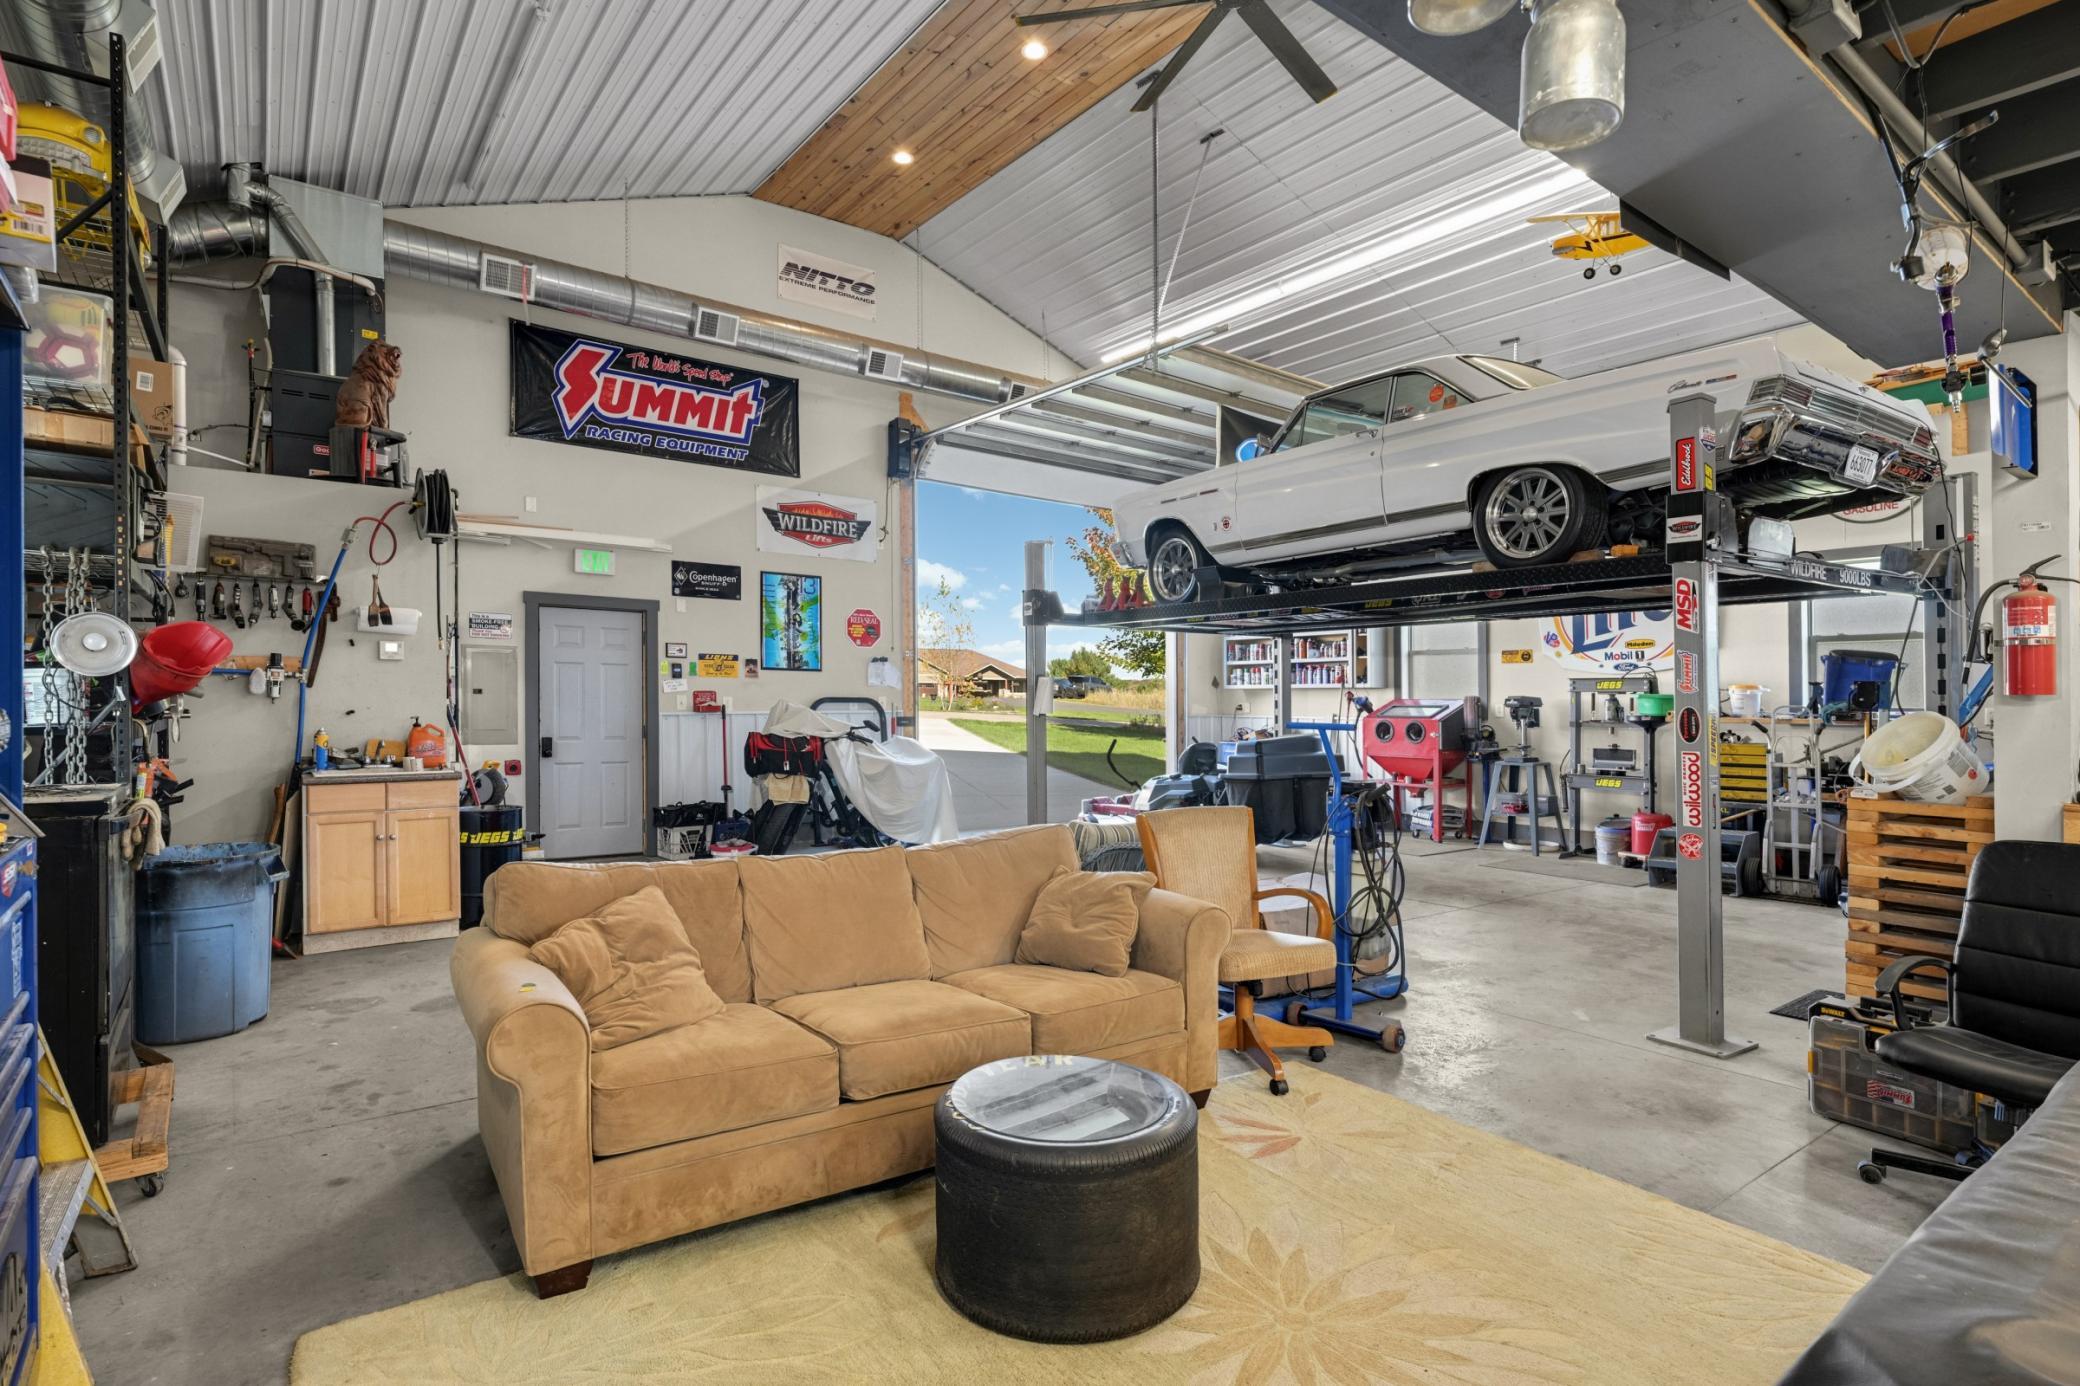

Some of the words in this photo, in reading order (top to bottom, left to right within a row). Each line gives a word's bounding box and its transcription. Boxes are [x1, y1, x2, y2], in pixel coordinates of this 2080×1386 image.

[779, 275, 817, 290] EXTREME
[818, 286, 876, 305] PERFORMANCE
[780, 261, 875, 296] NITTO
[627, 352, 649, 369] The
[652, 357, 681, 373] World's
[682, 365, 707, 382] Speed
[707, 369, 732, 386] Shop
[585, 424, 651, 446] RACING
[654, 437, 749, 461] EQUIPMENT
[1681, 441, 1692, 485] Edelbrock
[777, 512, 858, 539] WILDFIRE
[805, 534, 833, 544] Lifts
[689, 570, 737, 586] Copenhagen
[1790, 560, 1827, 581] WILDFIRE
[1839, 568, 1872, 586] 9000LBS
[1676, 579, 1692, 630] MSD
[850, 616, 862, 624] RED
[864, 617, 879, 625] SEAL
[1604, 651, 1633, 661] Mobil
[1596, 681, 1623, 690] JEGS
[1595, 778, 1622, 788] JEGS
[1683, 752, 1702, 827] wilwood
[470, 831, 510, 844] JEGS
